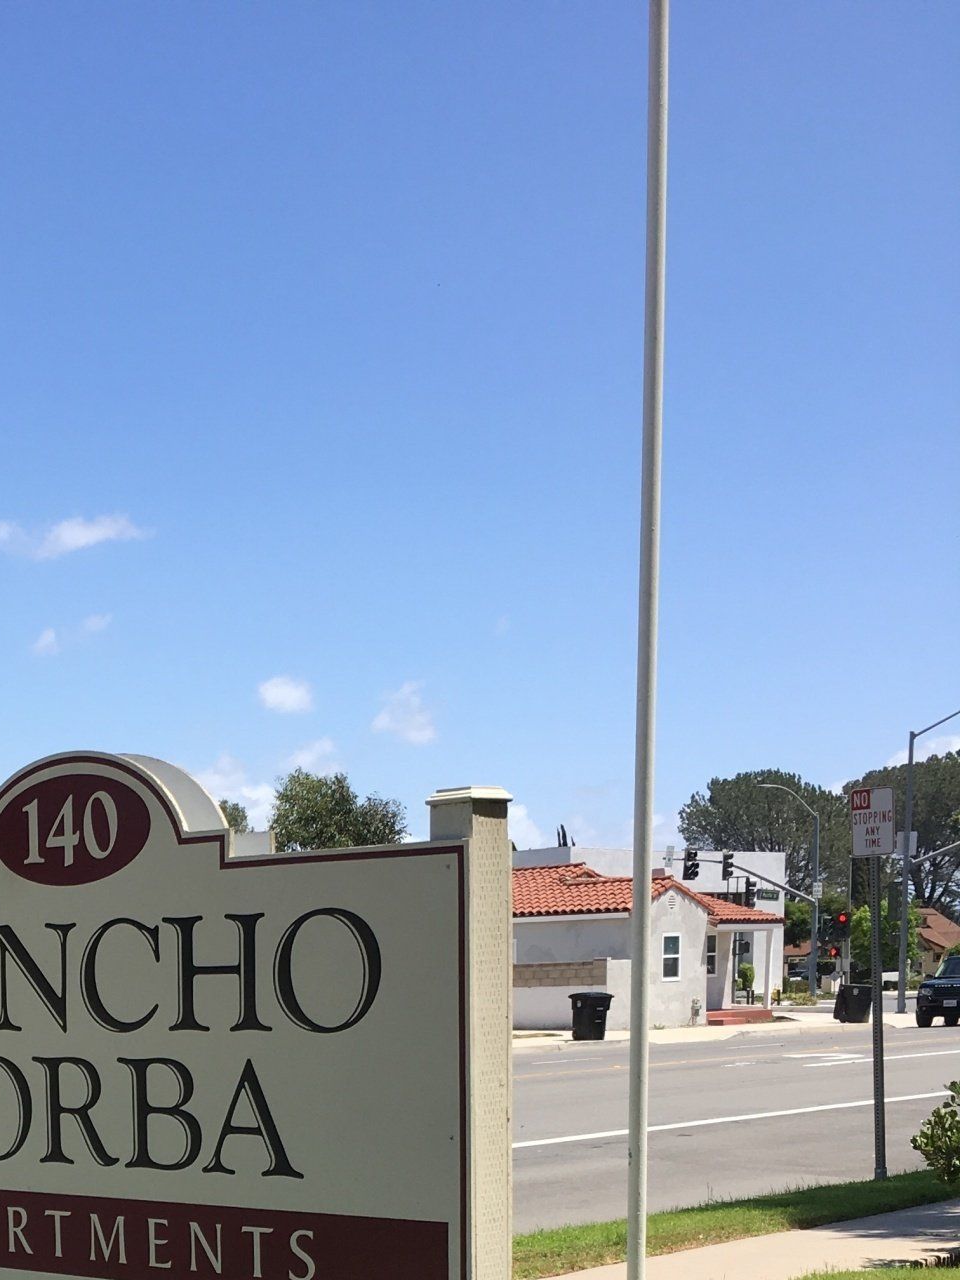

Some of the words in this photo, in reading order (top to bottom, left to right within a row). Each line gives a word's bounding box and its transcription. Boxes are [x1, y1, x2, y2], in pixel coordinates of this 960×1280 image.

[853, 792, 868, 808] NO
[853, 810, 892, 825] STOPPING
[22, 790, 118, 867] 140
[865, 826, 880, 836] ANY
[865, 838, 881, 848] TIME
